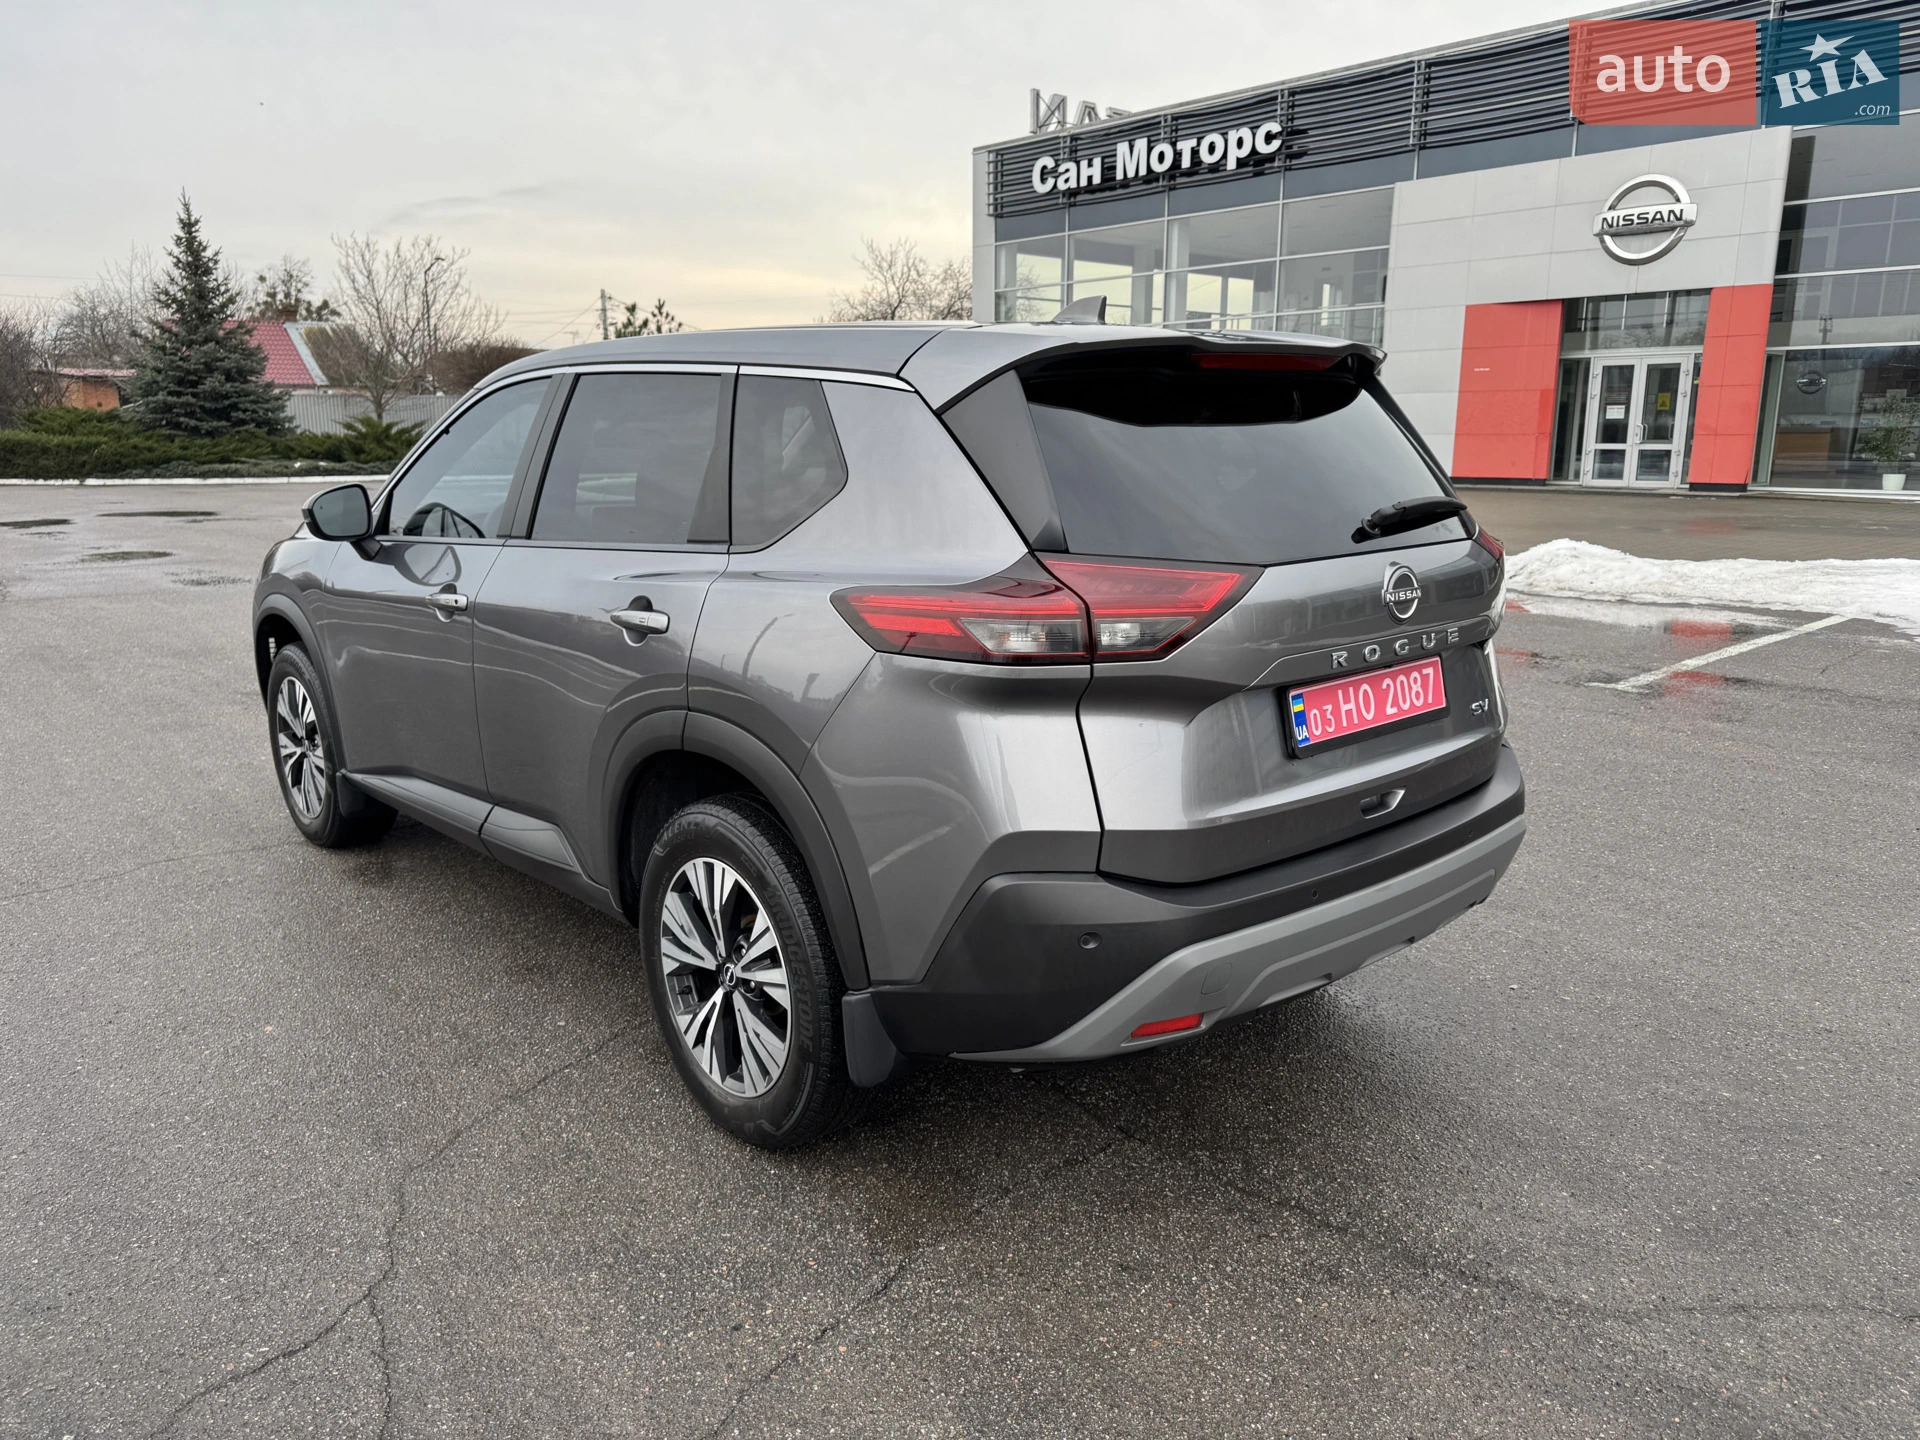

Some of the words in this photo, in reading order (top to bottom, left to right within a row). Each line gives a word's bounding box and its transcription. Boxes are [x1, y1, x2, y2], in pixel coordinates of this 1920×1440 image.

[1031, 156, 1102, 194] Сан
[1115, 121, 1283, 181] Моторс
[1601, 208, 1685, 230] NISSAN
[1386, 588, 1421, 603] NISSAN
[1331, 627, 1459, 669] ROGUE
[1381, 666, 1434, 716] 2087
[1470, 698, 1490, 716] SV
[1296, 724, 1310, 740] UA
